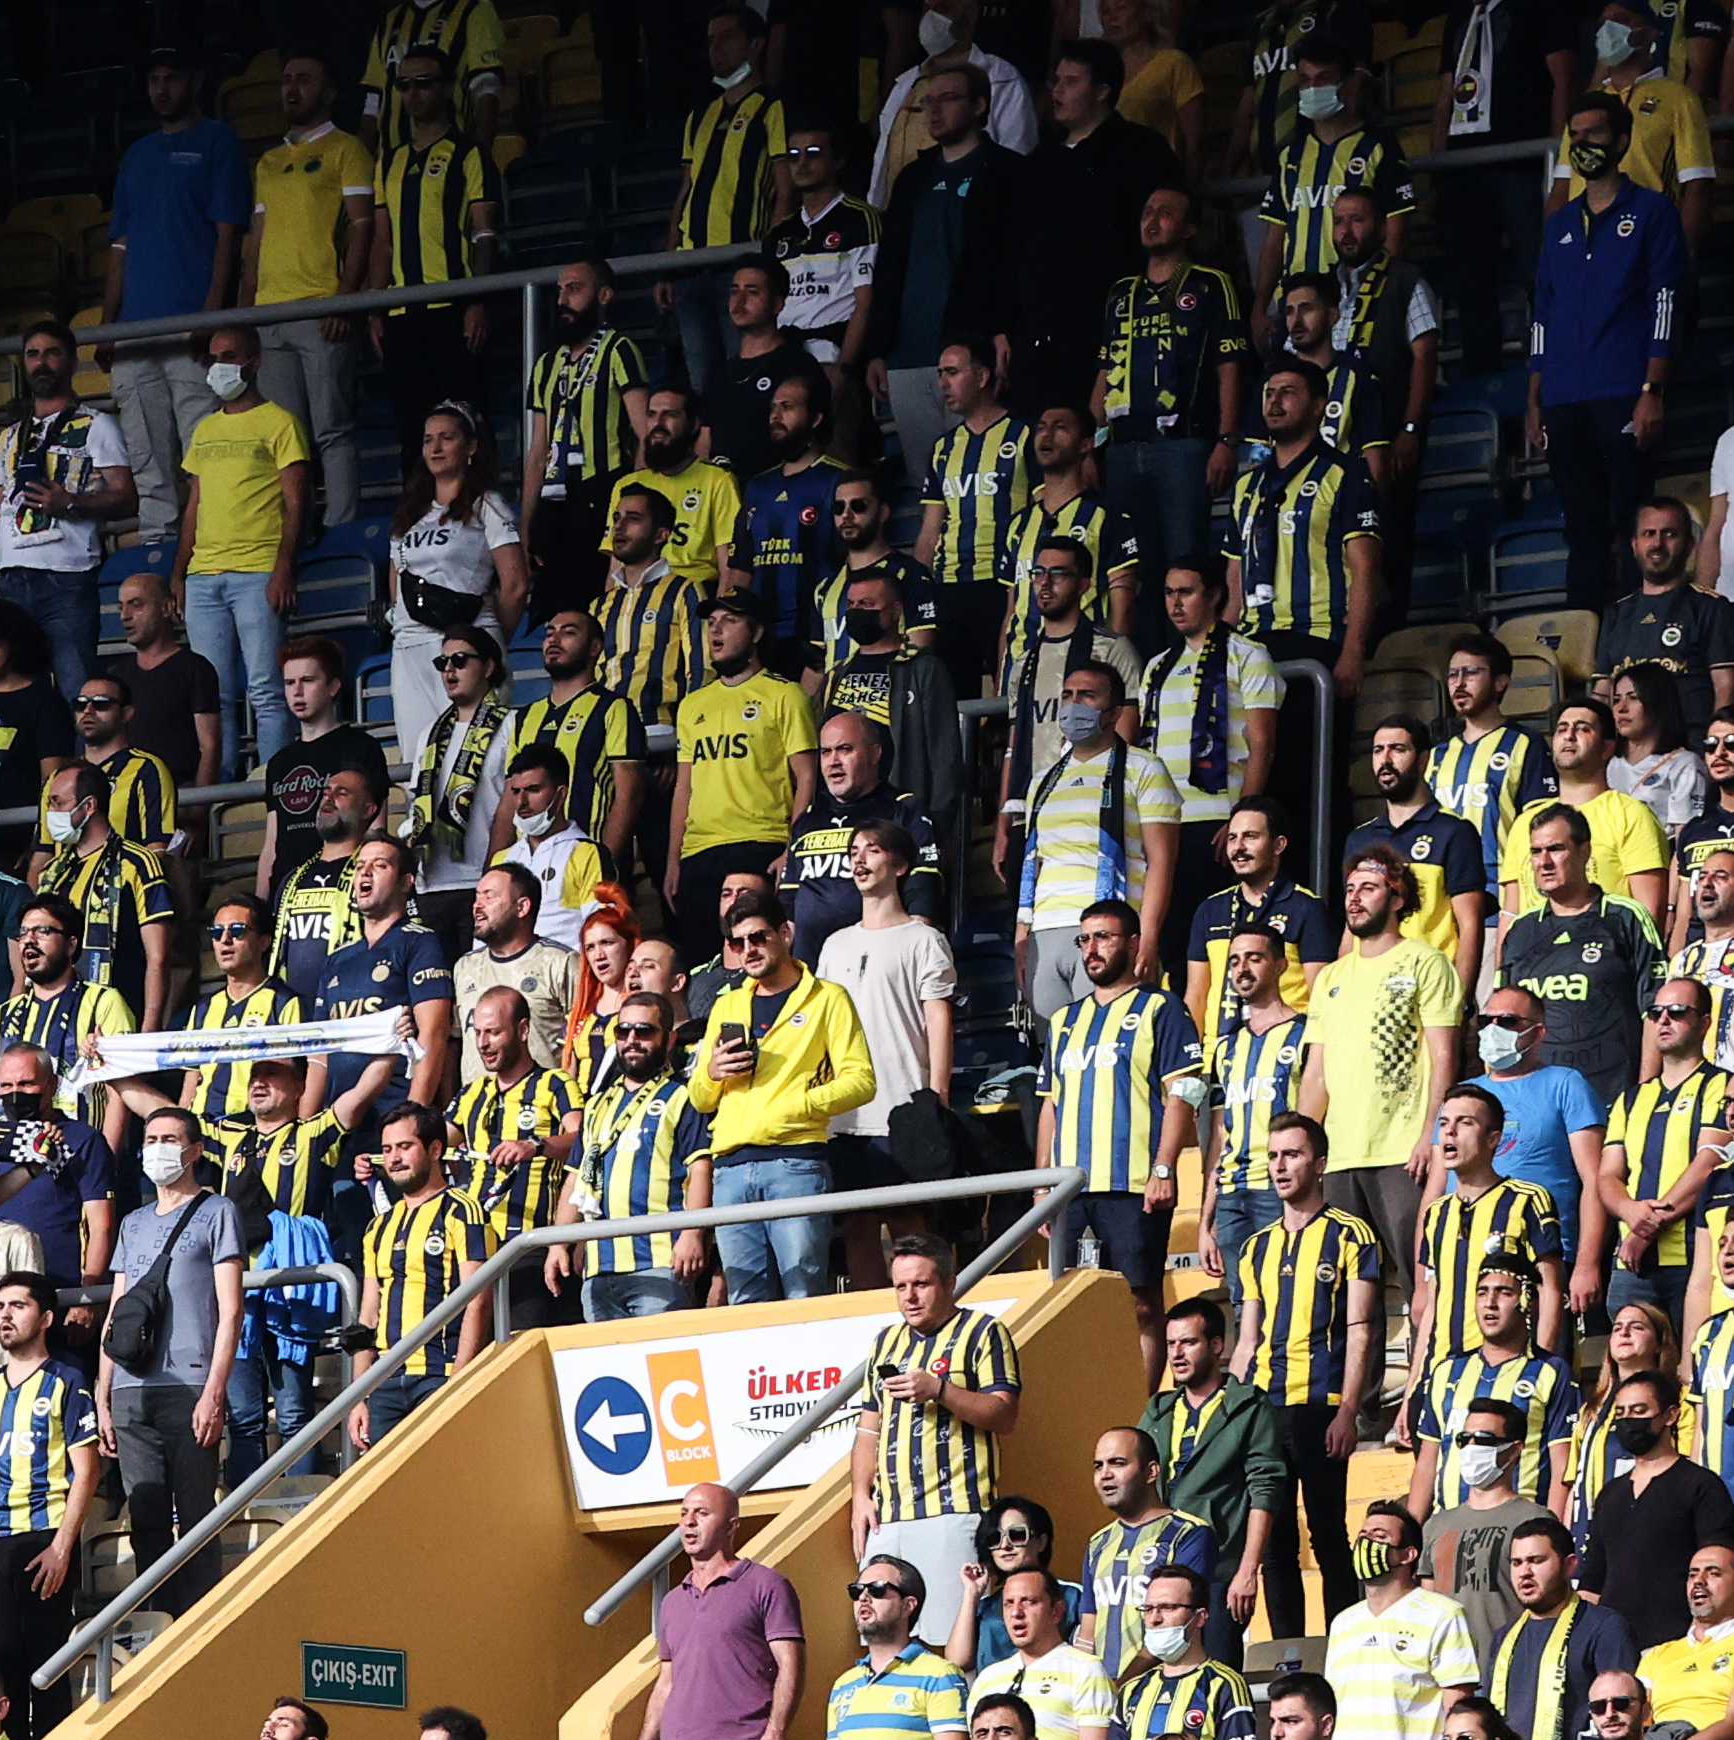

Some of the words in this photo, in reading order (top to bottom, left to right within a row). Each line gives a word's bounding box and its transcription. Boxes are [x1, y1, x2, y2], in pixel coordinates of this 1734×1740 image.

[941, 471, 999, 499] AVIS
[693, 734, 749, 765] AVIS
[1060, 1043, 1116, 1070] AVIS
[1225, 1076, 1275, 1107] AVIS
[747, 1365, 842, 1401] ÜLKER
[658, 1378, 705, 1441] C
[665, 1445, 712, 1463] BLOCK
[311, 1659, 398, 1691] ÇIKIŞ-EXIT
